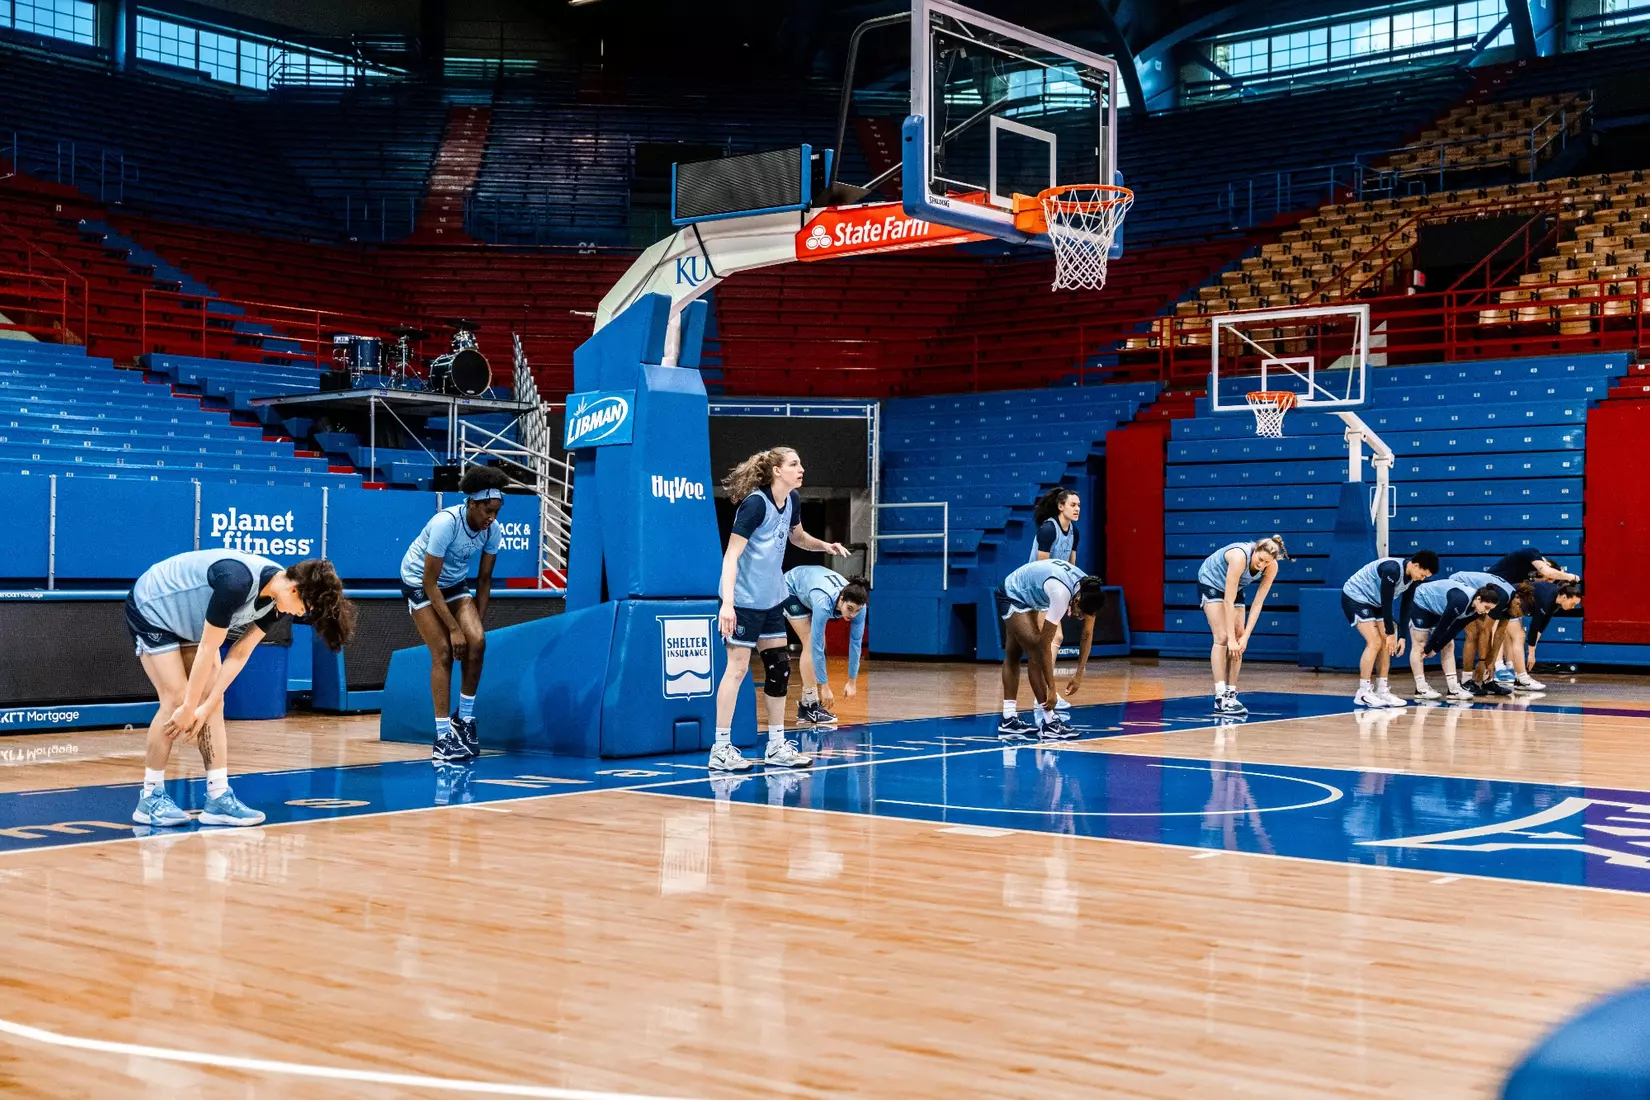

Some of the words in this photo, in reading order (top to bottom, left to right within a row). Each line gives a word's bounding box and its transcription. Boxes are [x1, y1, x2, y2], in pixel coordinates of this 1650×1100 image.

[675, 256, 709, 287] KU
[566, 403, 622, 446] LIBMAN
[211, 507, 294, 537] planet
[523, 524, 531, 535] &
[223, 531, 312, 555] fitness
[667, 637, 708, 649] SHELTER
[667, 648, 708, 658] INSURANCE
[27, 711, 79, 723] Mortgage
